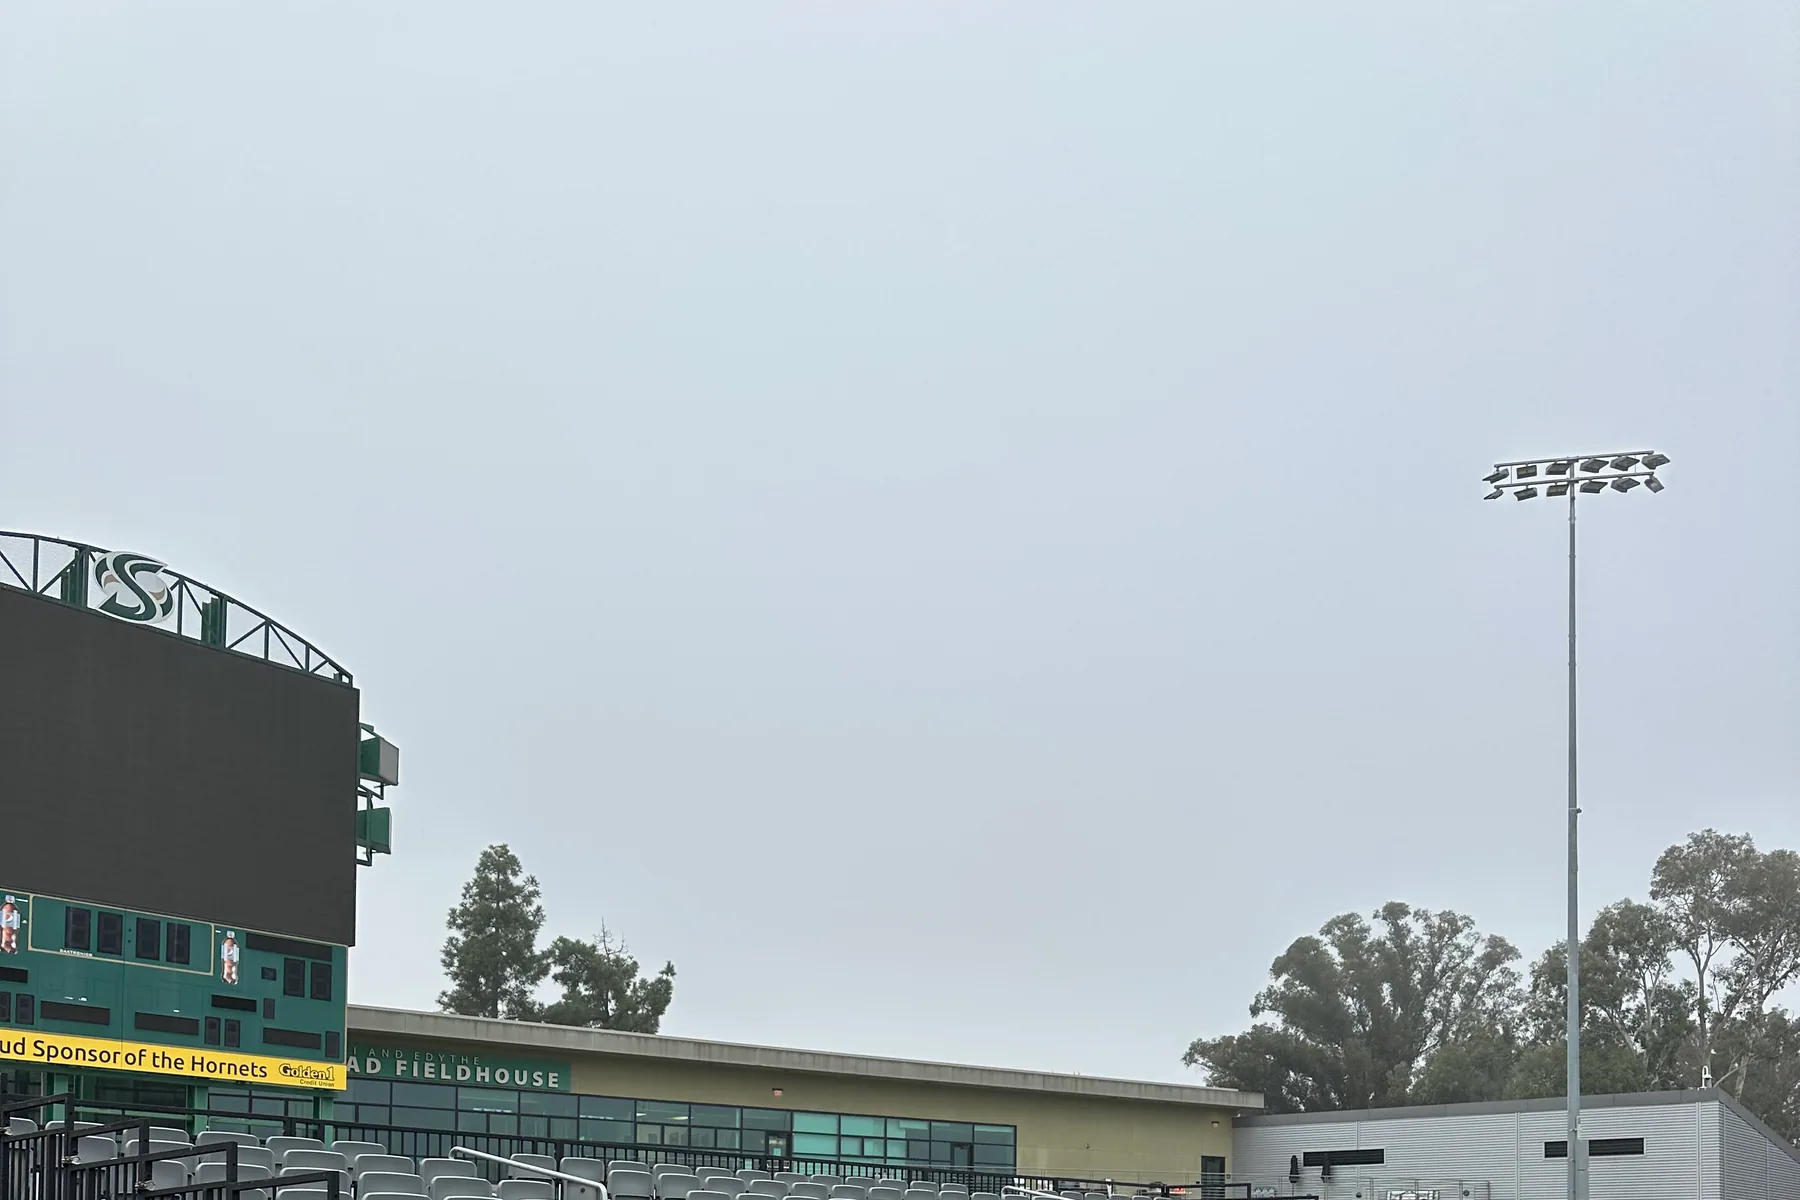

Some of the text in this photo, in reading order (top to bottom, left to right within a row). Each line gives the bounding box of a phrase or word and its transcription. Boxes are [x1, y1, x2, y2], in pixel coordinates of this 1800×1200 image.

[33, 1039, 120, 1063] Sponsor
[124, 1049, 147, 1066] of
[152, 1051, 185, 1070] the
[191, 1055, 268, 1078] Hornets
[368, 1048, 404, 1059] AND
[414, 1052, 480, 1066] EDYTHE
[396, 1060, 559, 1088] FIELDHOUSE
